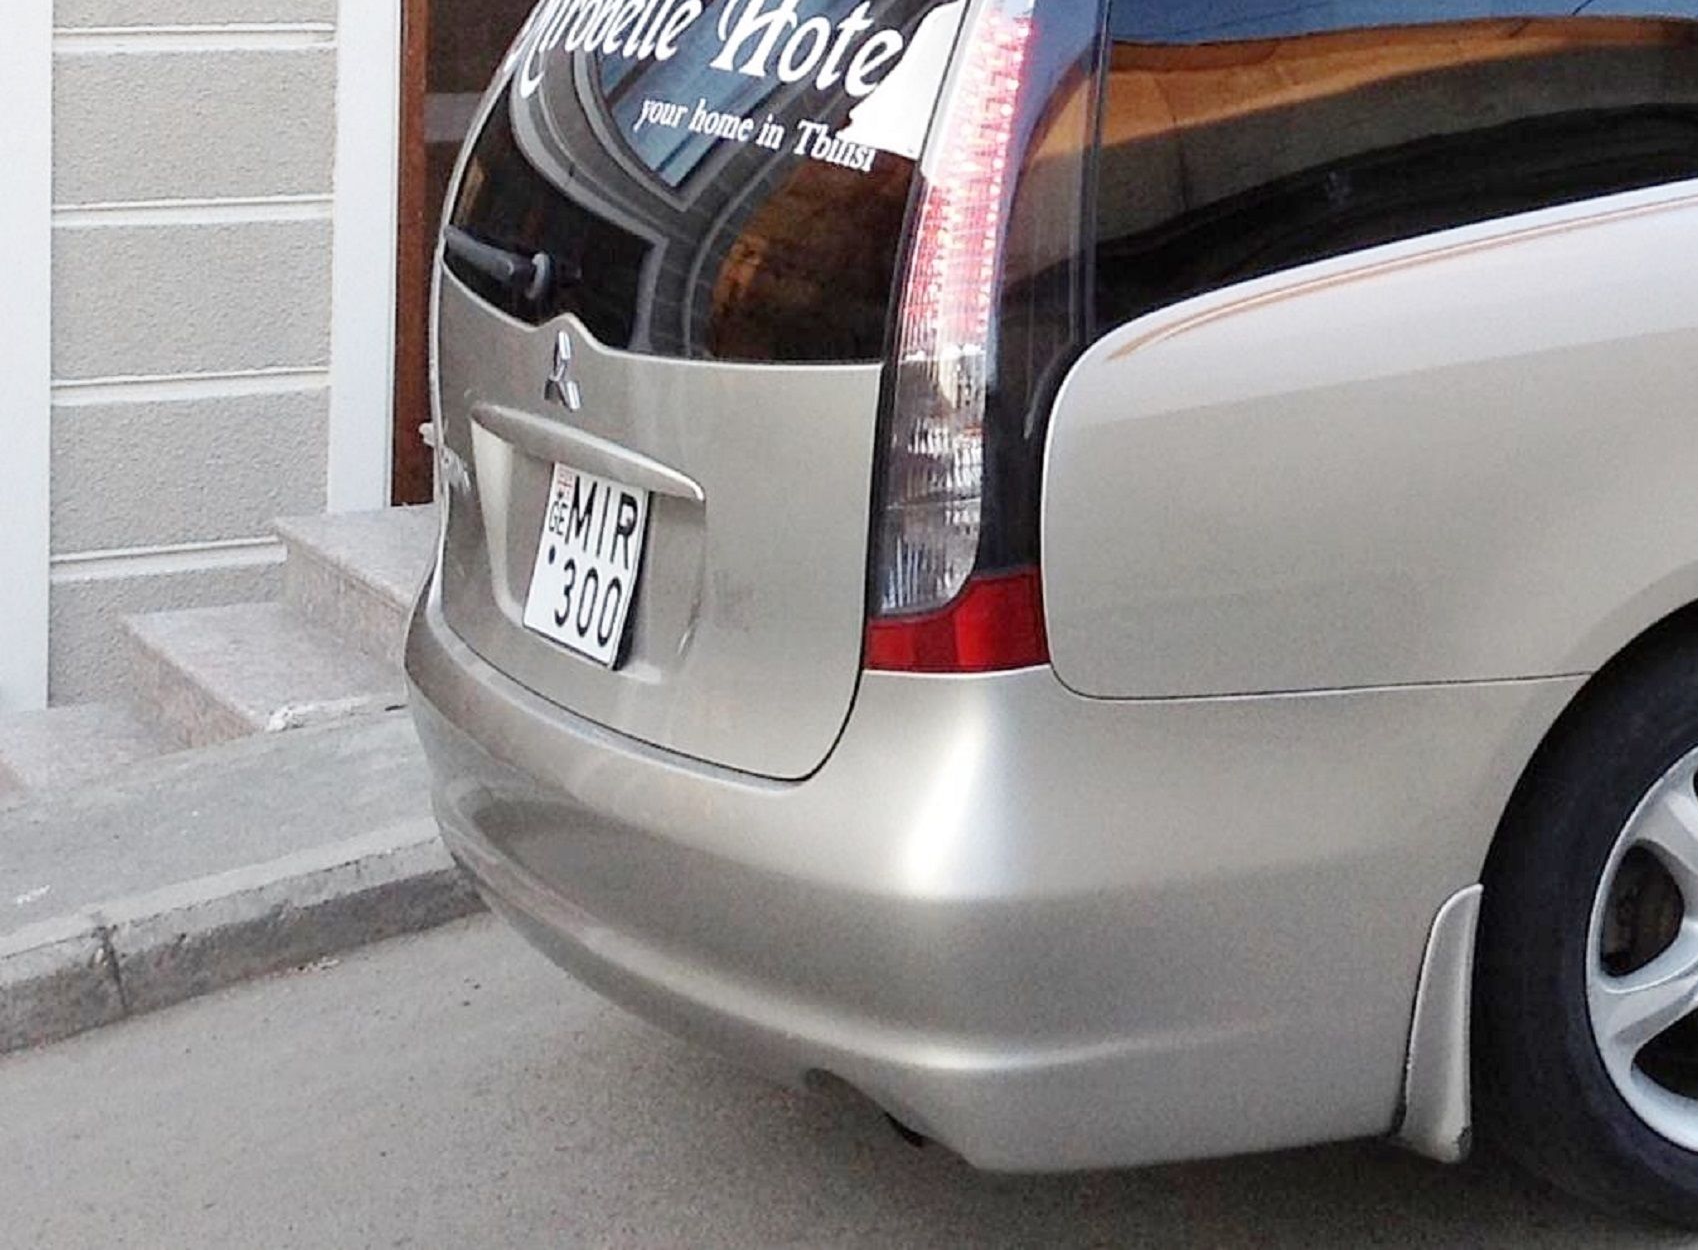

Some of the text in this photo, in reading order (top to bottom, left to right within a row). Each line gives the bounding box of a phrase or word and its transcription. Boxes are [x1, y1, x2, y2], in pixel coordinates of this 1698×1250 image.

[633, 98, 688, 133] your
[688, 97, 754, 142] home
[756, 113, 784, 150] in
[549, 500, 569, 536] GE
[564, 476, 639, 570] MIR
[554, 558, 622, 648] 300
